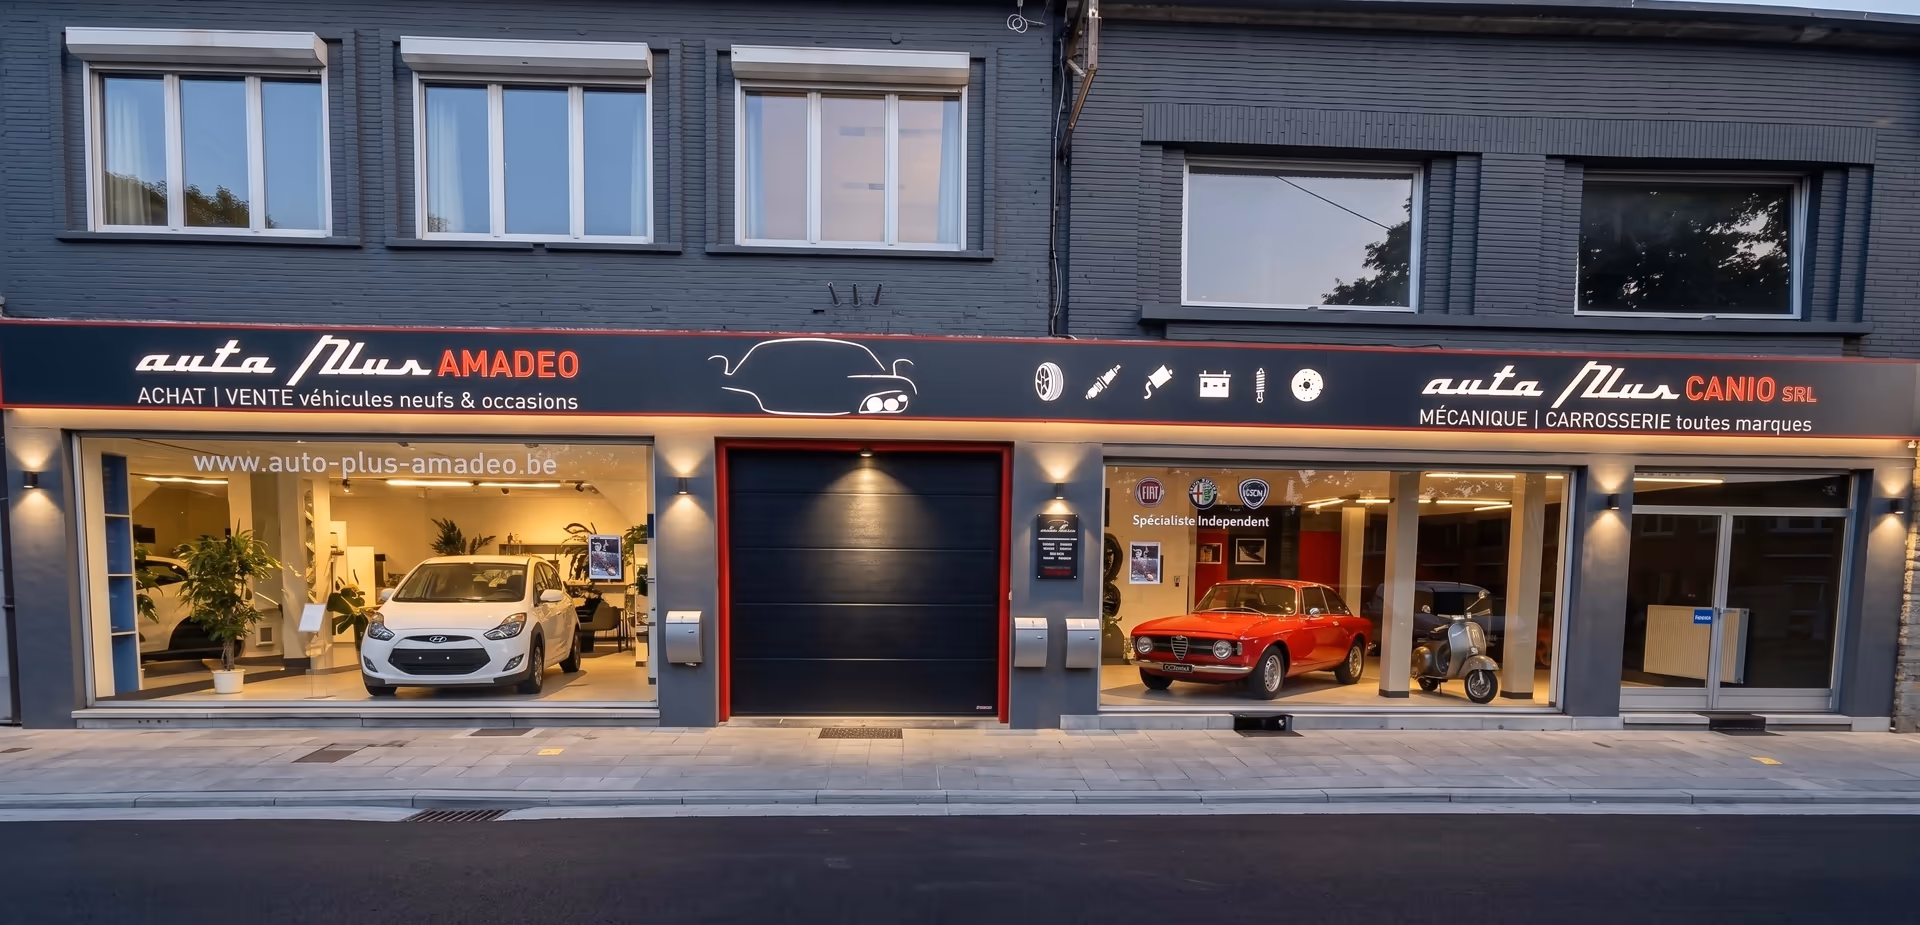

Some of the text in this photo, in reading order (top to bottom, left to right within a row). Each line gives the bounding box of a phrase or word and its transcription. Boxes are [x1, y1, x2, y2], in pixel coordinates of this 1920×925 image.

[437, 349, 579, 379] AMADEO
[137, 386, 206, 405] ACHAT
[225, 388, 294, 406] VENTE
[298, 388, 394, 408] véhicules
[400, 391, 454, 409] neufs
[460, 391, 476, 409] &
[482, 392, 578, 410] occasions
[1685, 375, 1776, 403] CANIO
[1781, 385, 1817, 403] SRL
[1419, 404, 1528, 427] MÉCANIQUE
[1545, 411, 1672, 430] CARROSSERIE
[1676, 415, 1731, 431] toutes
[1735, 419, 1812, 436] marques
[193, 451, 557, 480] www.auto-plus-amadeo.be
[1142, 485, 1159, 500] FIAT
[1133, 514, 1270, 529] Spécialiste Independent
